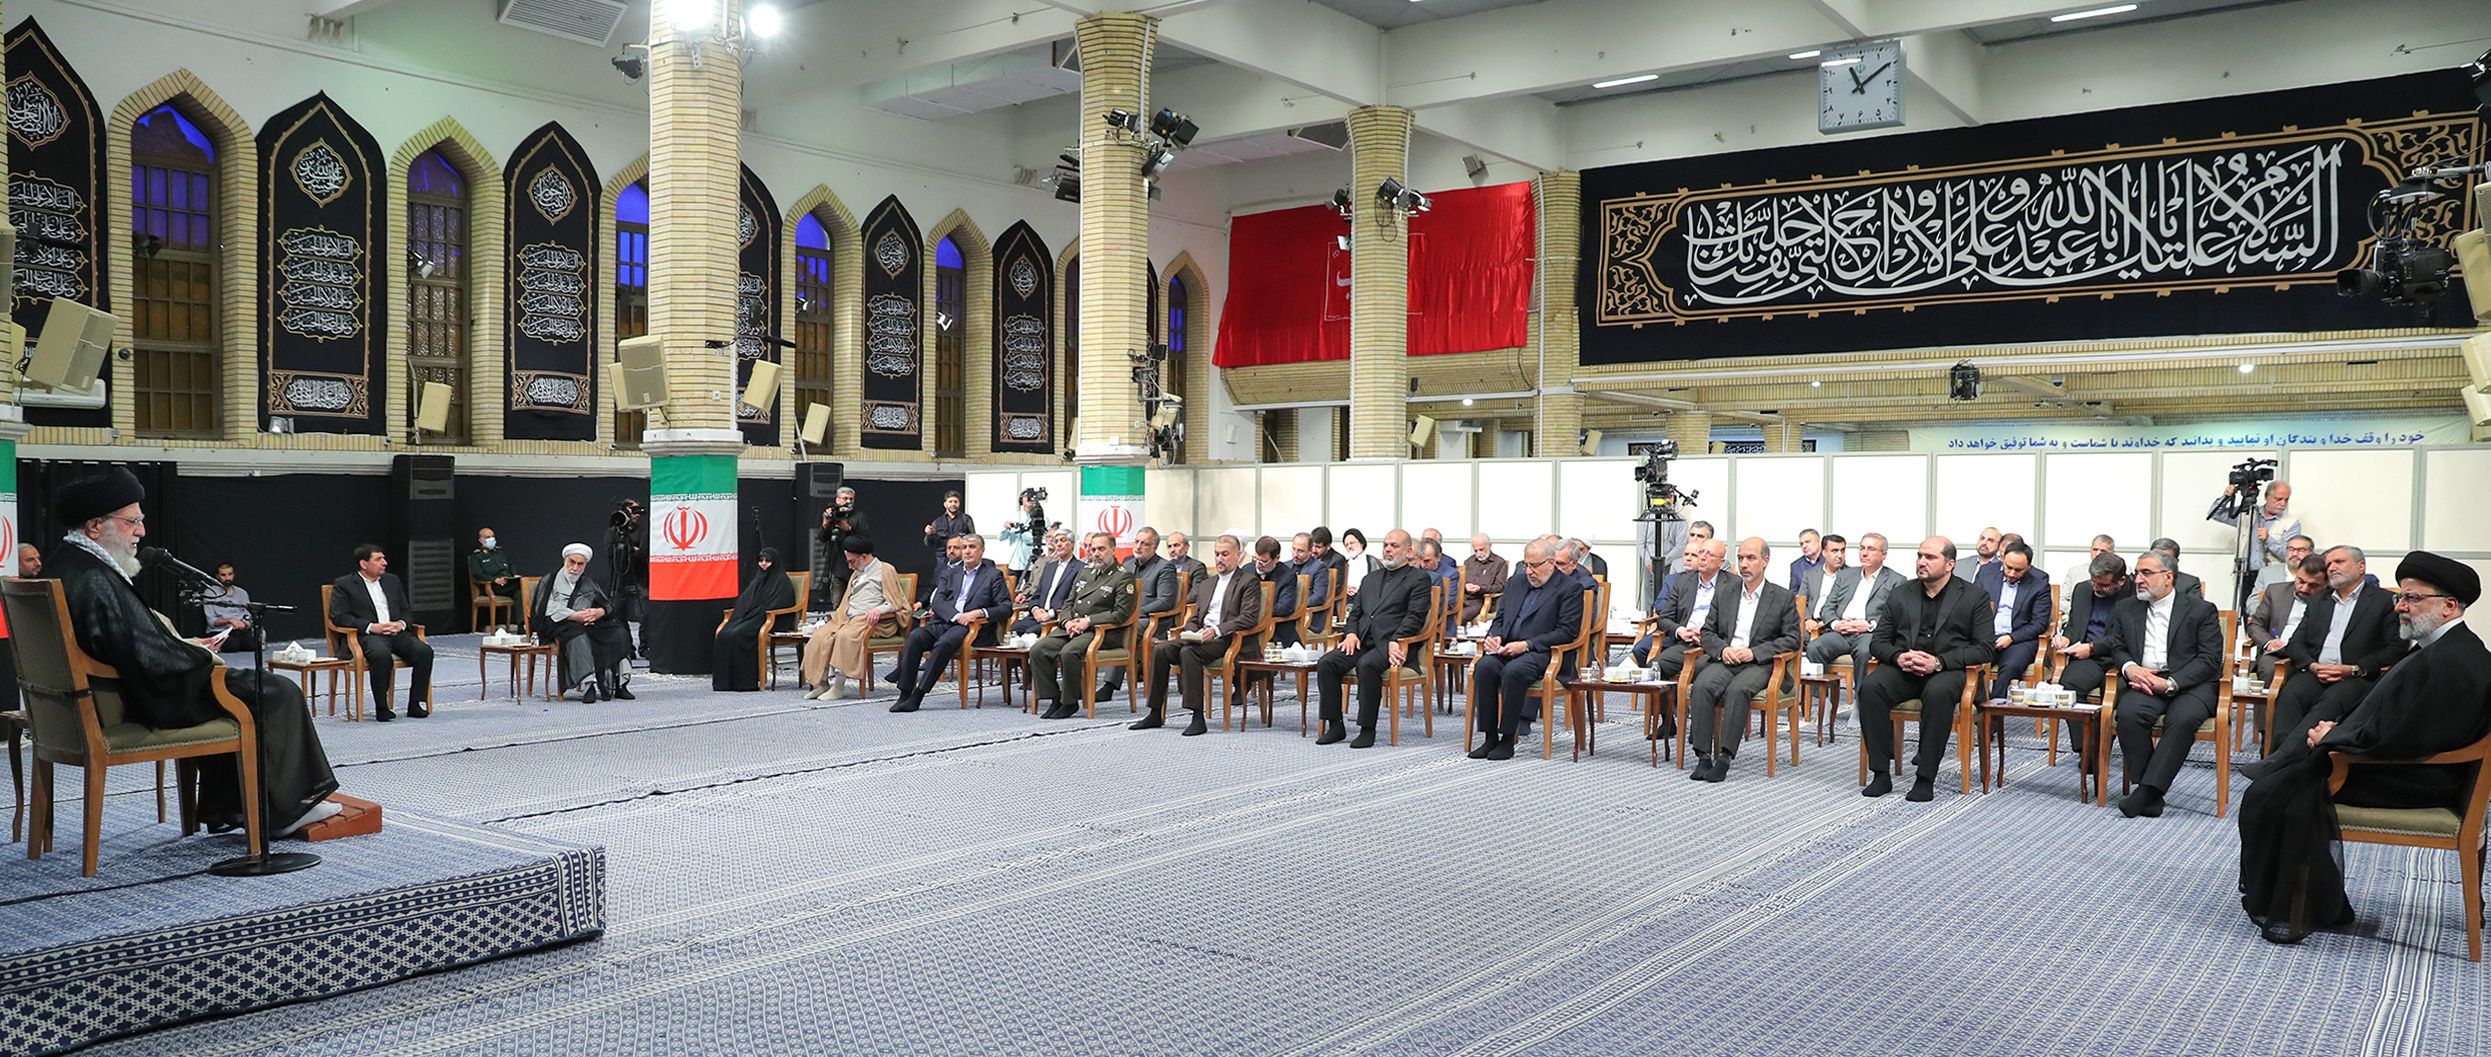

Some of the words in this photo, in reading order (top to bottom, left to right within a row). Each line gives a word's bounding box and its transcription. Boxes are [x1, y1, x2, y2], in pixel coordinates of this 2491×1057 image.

[2029, 437, 2047, 448] شما
[2122, 437, 2161, 448] خداوند
[2329, 433, 2352, 444] خدا
[2355, 432, 2381, 444] وقف
[2400, 430, 2424, 444] خود
[1948, 439, 1964, 448] داد
[1967, 438, 1997, 450] خواهد
[2000, 437, 2027, 450] توفیق
[2071, 439, 2107, 448] شماست
